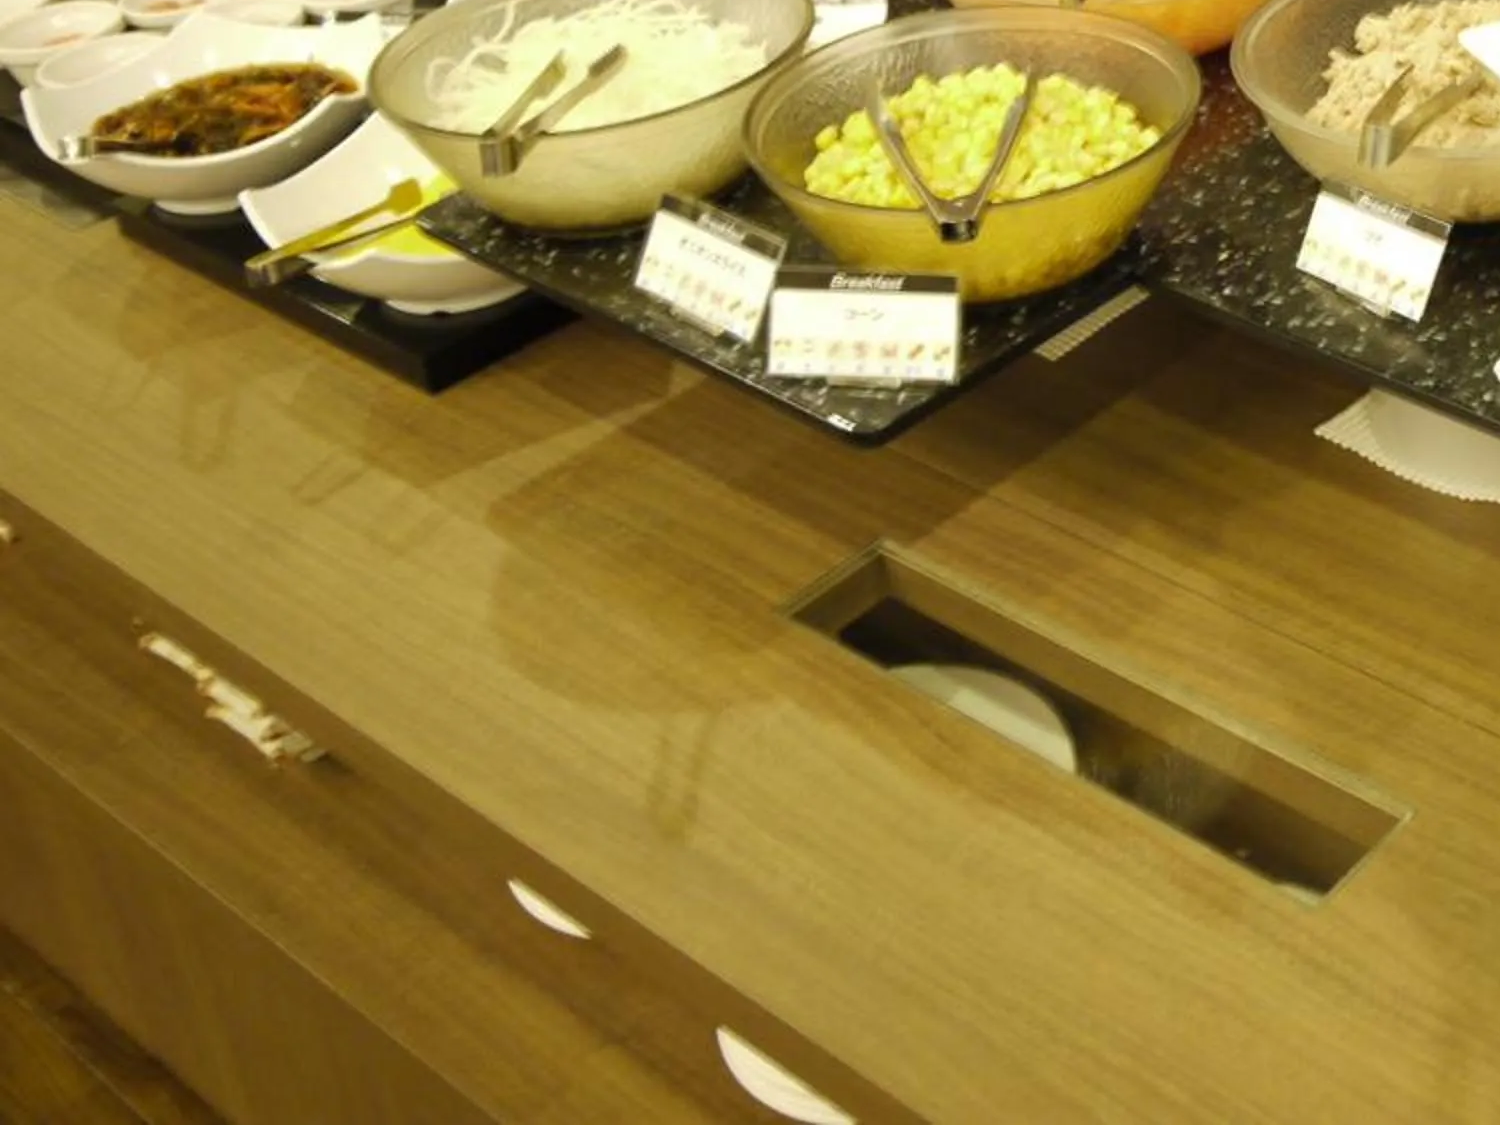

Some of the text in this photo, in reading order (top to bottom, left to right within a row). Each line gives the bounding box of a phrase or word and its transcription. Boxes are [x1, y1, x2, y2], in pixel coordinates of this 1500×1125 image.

[829, 273, 906, 292] Breakfast
[843, 307, 884, 322] コーン
